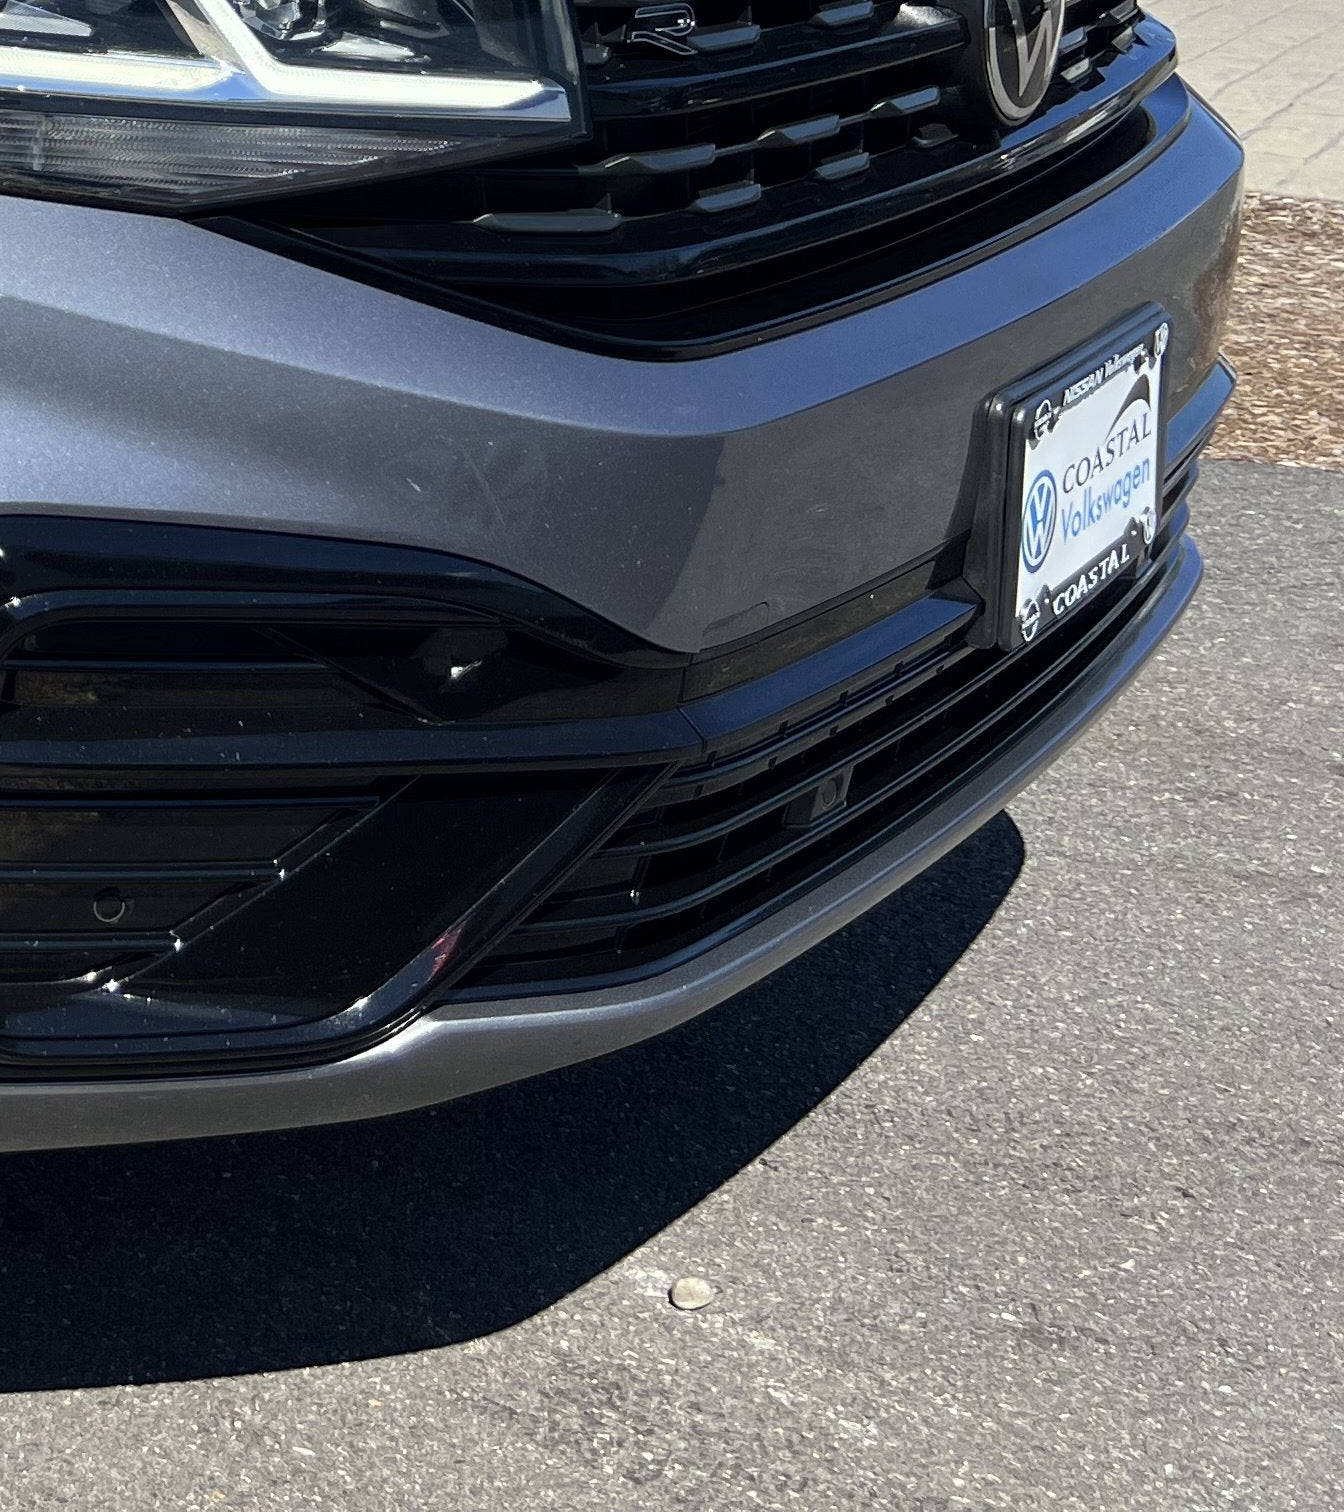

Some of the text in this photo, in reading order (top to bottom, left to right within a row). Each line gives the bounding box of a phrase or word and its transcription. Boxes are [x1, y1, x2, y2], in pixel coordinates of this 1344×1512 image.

[626, 3, 698, 55] R
[1062, 412, 1152, 495] COASTAL
[1024, 479, 1056, 567] VW
[1062, 457, 1151, 544] Volkswagen
[1052, 543, 1131, 616] COASTAL
